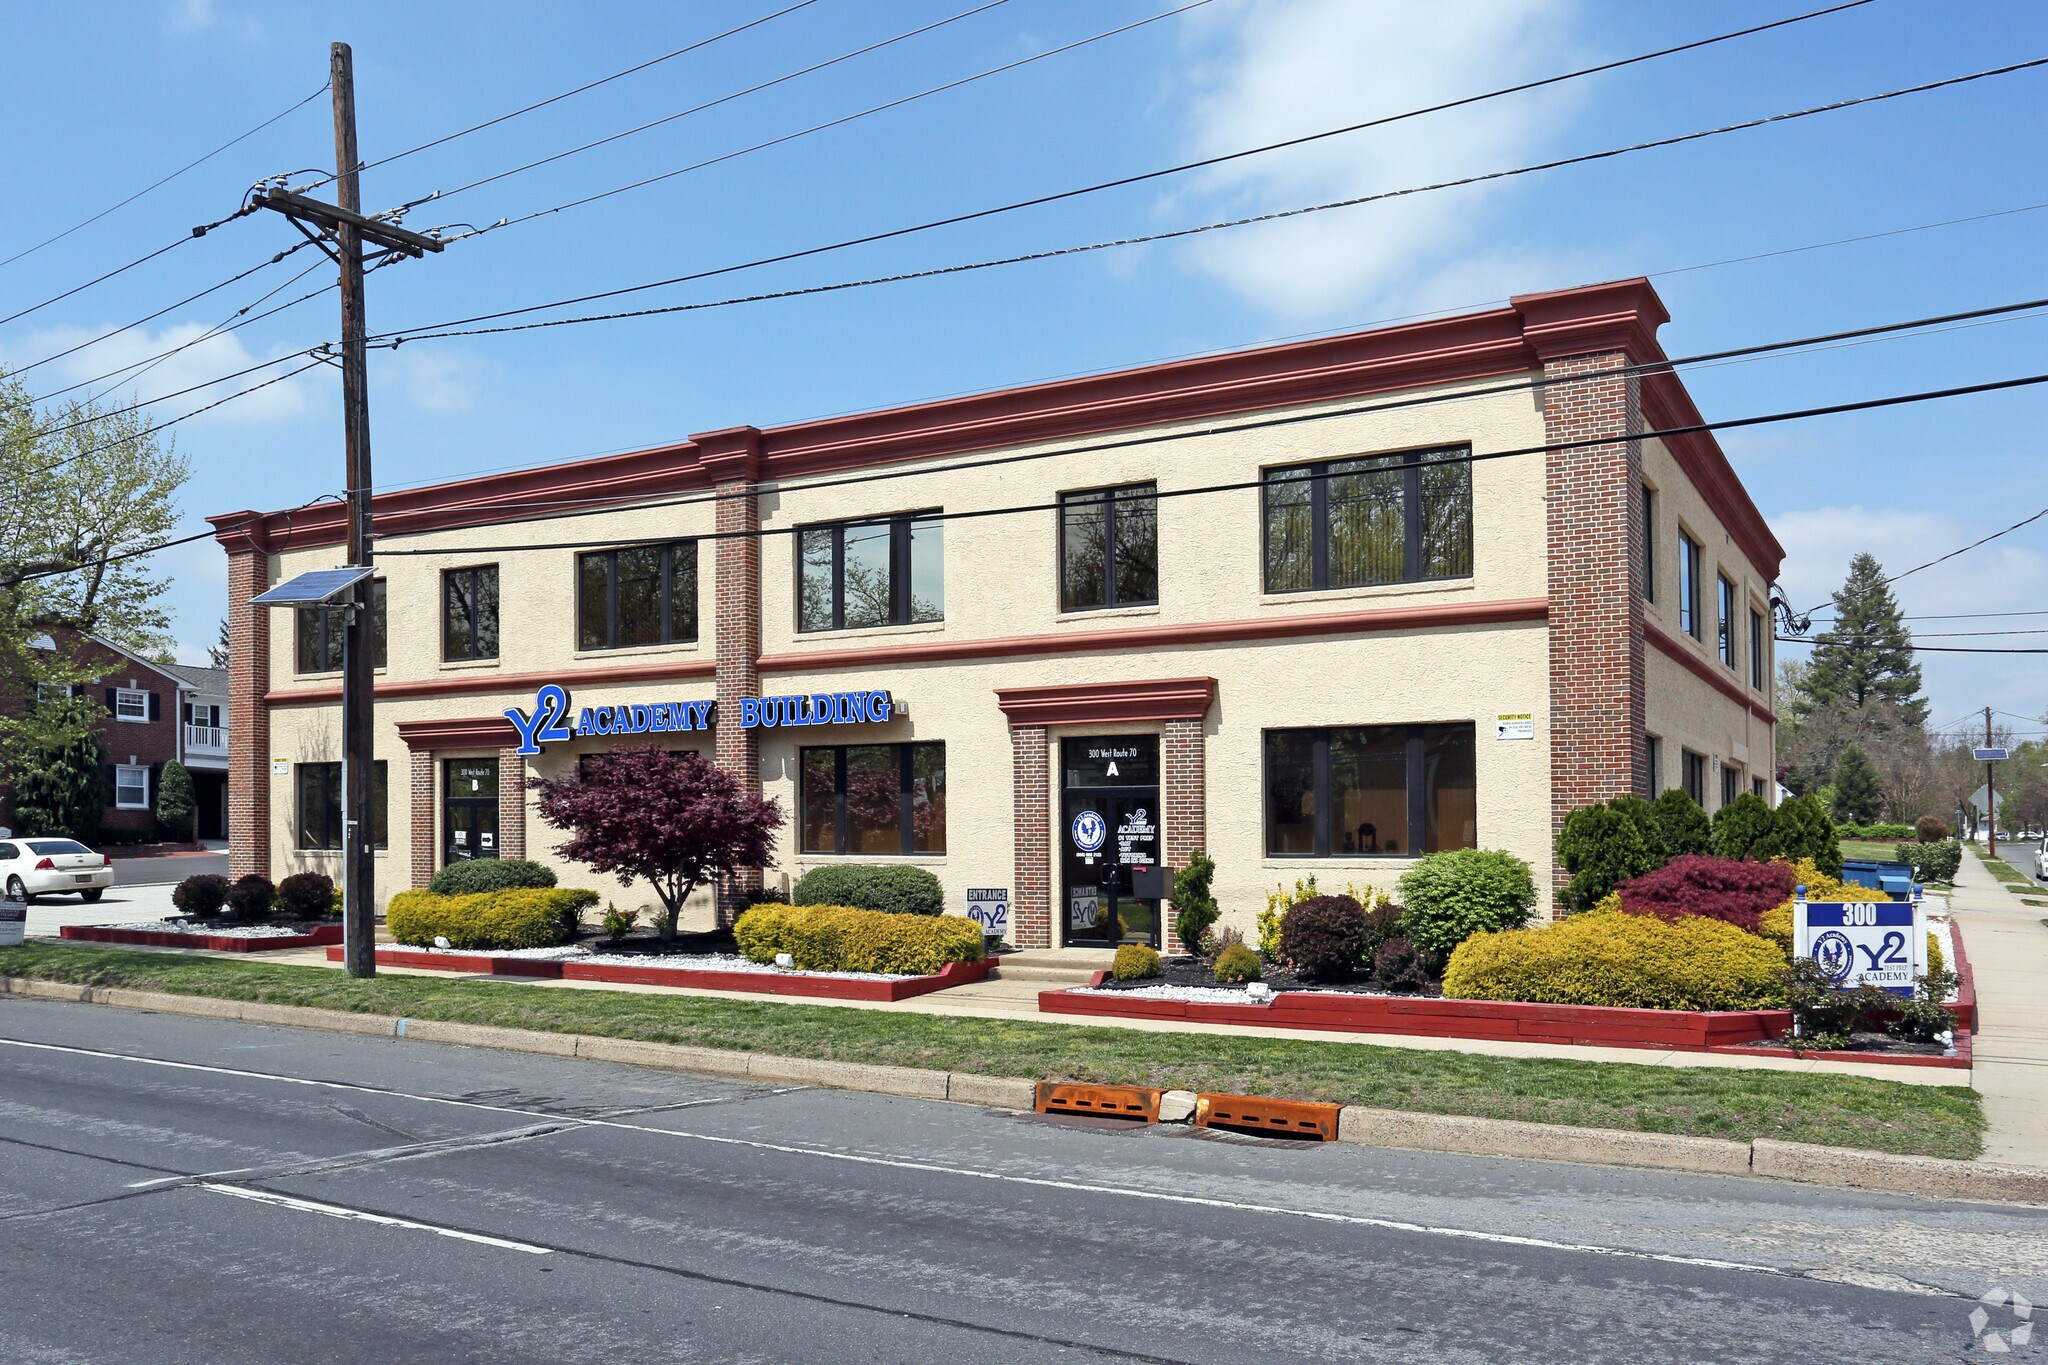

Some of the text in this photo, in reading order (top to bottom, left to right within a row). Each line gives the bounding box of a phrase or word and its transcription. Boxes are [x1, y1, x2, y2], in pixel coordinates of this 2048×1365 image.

[502, 684, 570, 755] Y2
[576, 690, 892, 736] ACADEMY BUILDING
[1088, 748, 1137, 758] 300 West Route 70
[1106, 761, 1119, 777] A
[472, 779, 479, 791] B
[1125, 808, 1147, 824] Y2
[1117, 825, 1155, 834] ACADEMY
[968, 890, 1006, 900] ENTRANCE
[984, 904, 1007, 929] Y2
[1842, 903, 1877, 926] 300
[1826, 932, 1848, 944] Academy
[1856, 931, 1907, 971] Y2
[1859, 972, 1908, 981] ACADEMY
